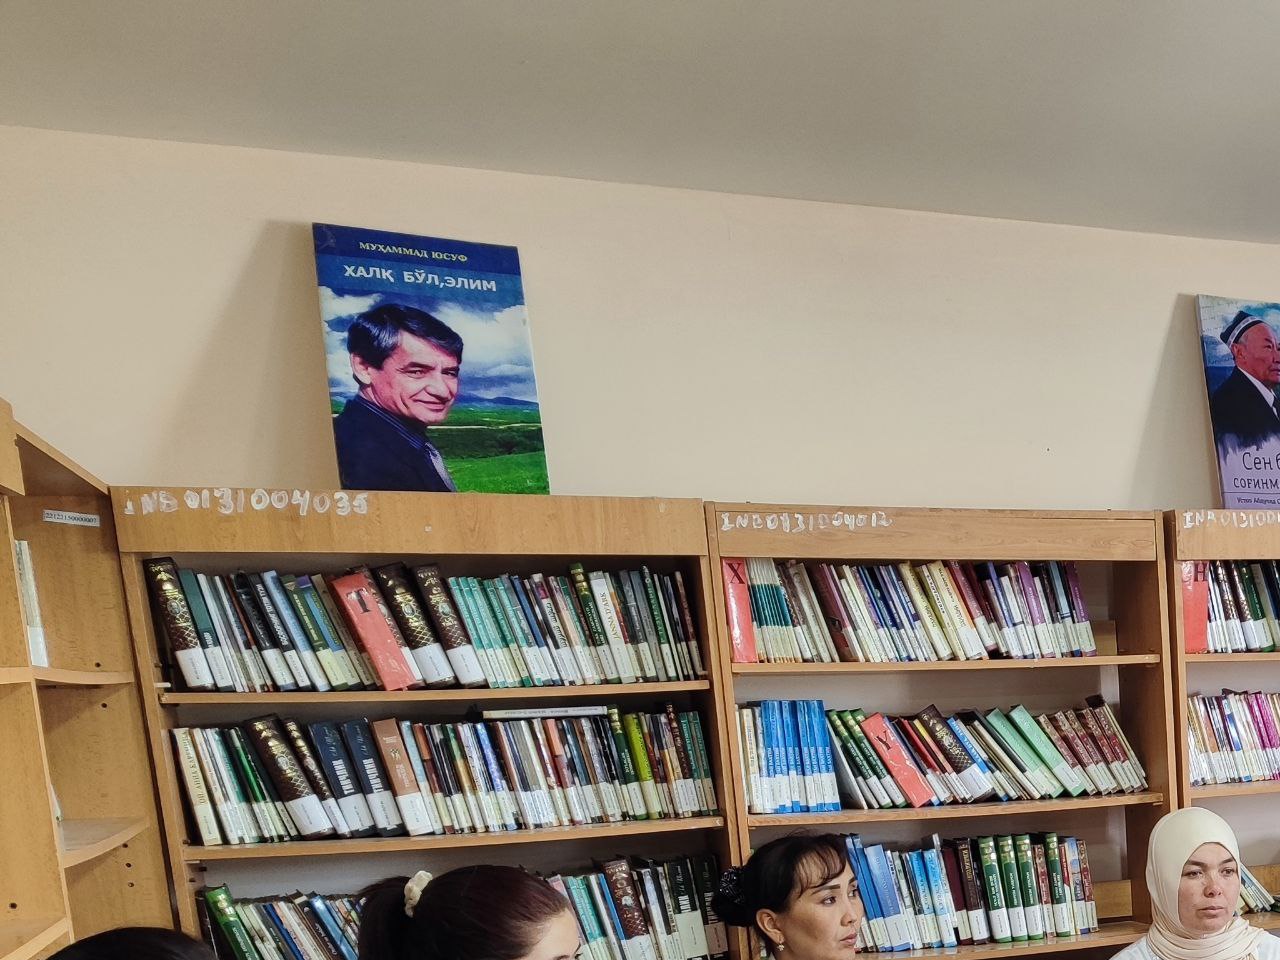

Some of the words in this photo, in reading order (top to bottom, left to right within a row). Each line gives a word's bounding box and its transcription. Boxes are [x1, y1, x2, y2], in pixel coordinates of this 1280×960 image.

[359, 241, 428, 259] МУҲАММАД
[432, 251, 468, 262] ЮСУФ
[344, 264, 395, 283] ХАЛҚ
[1242, 452, 1273, 470] Сен
